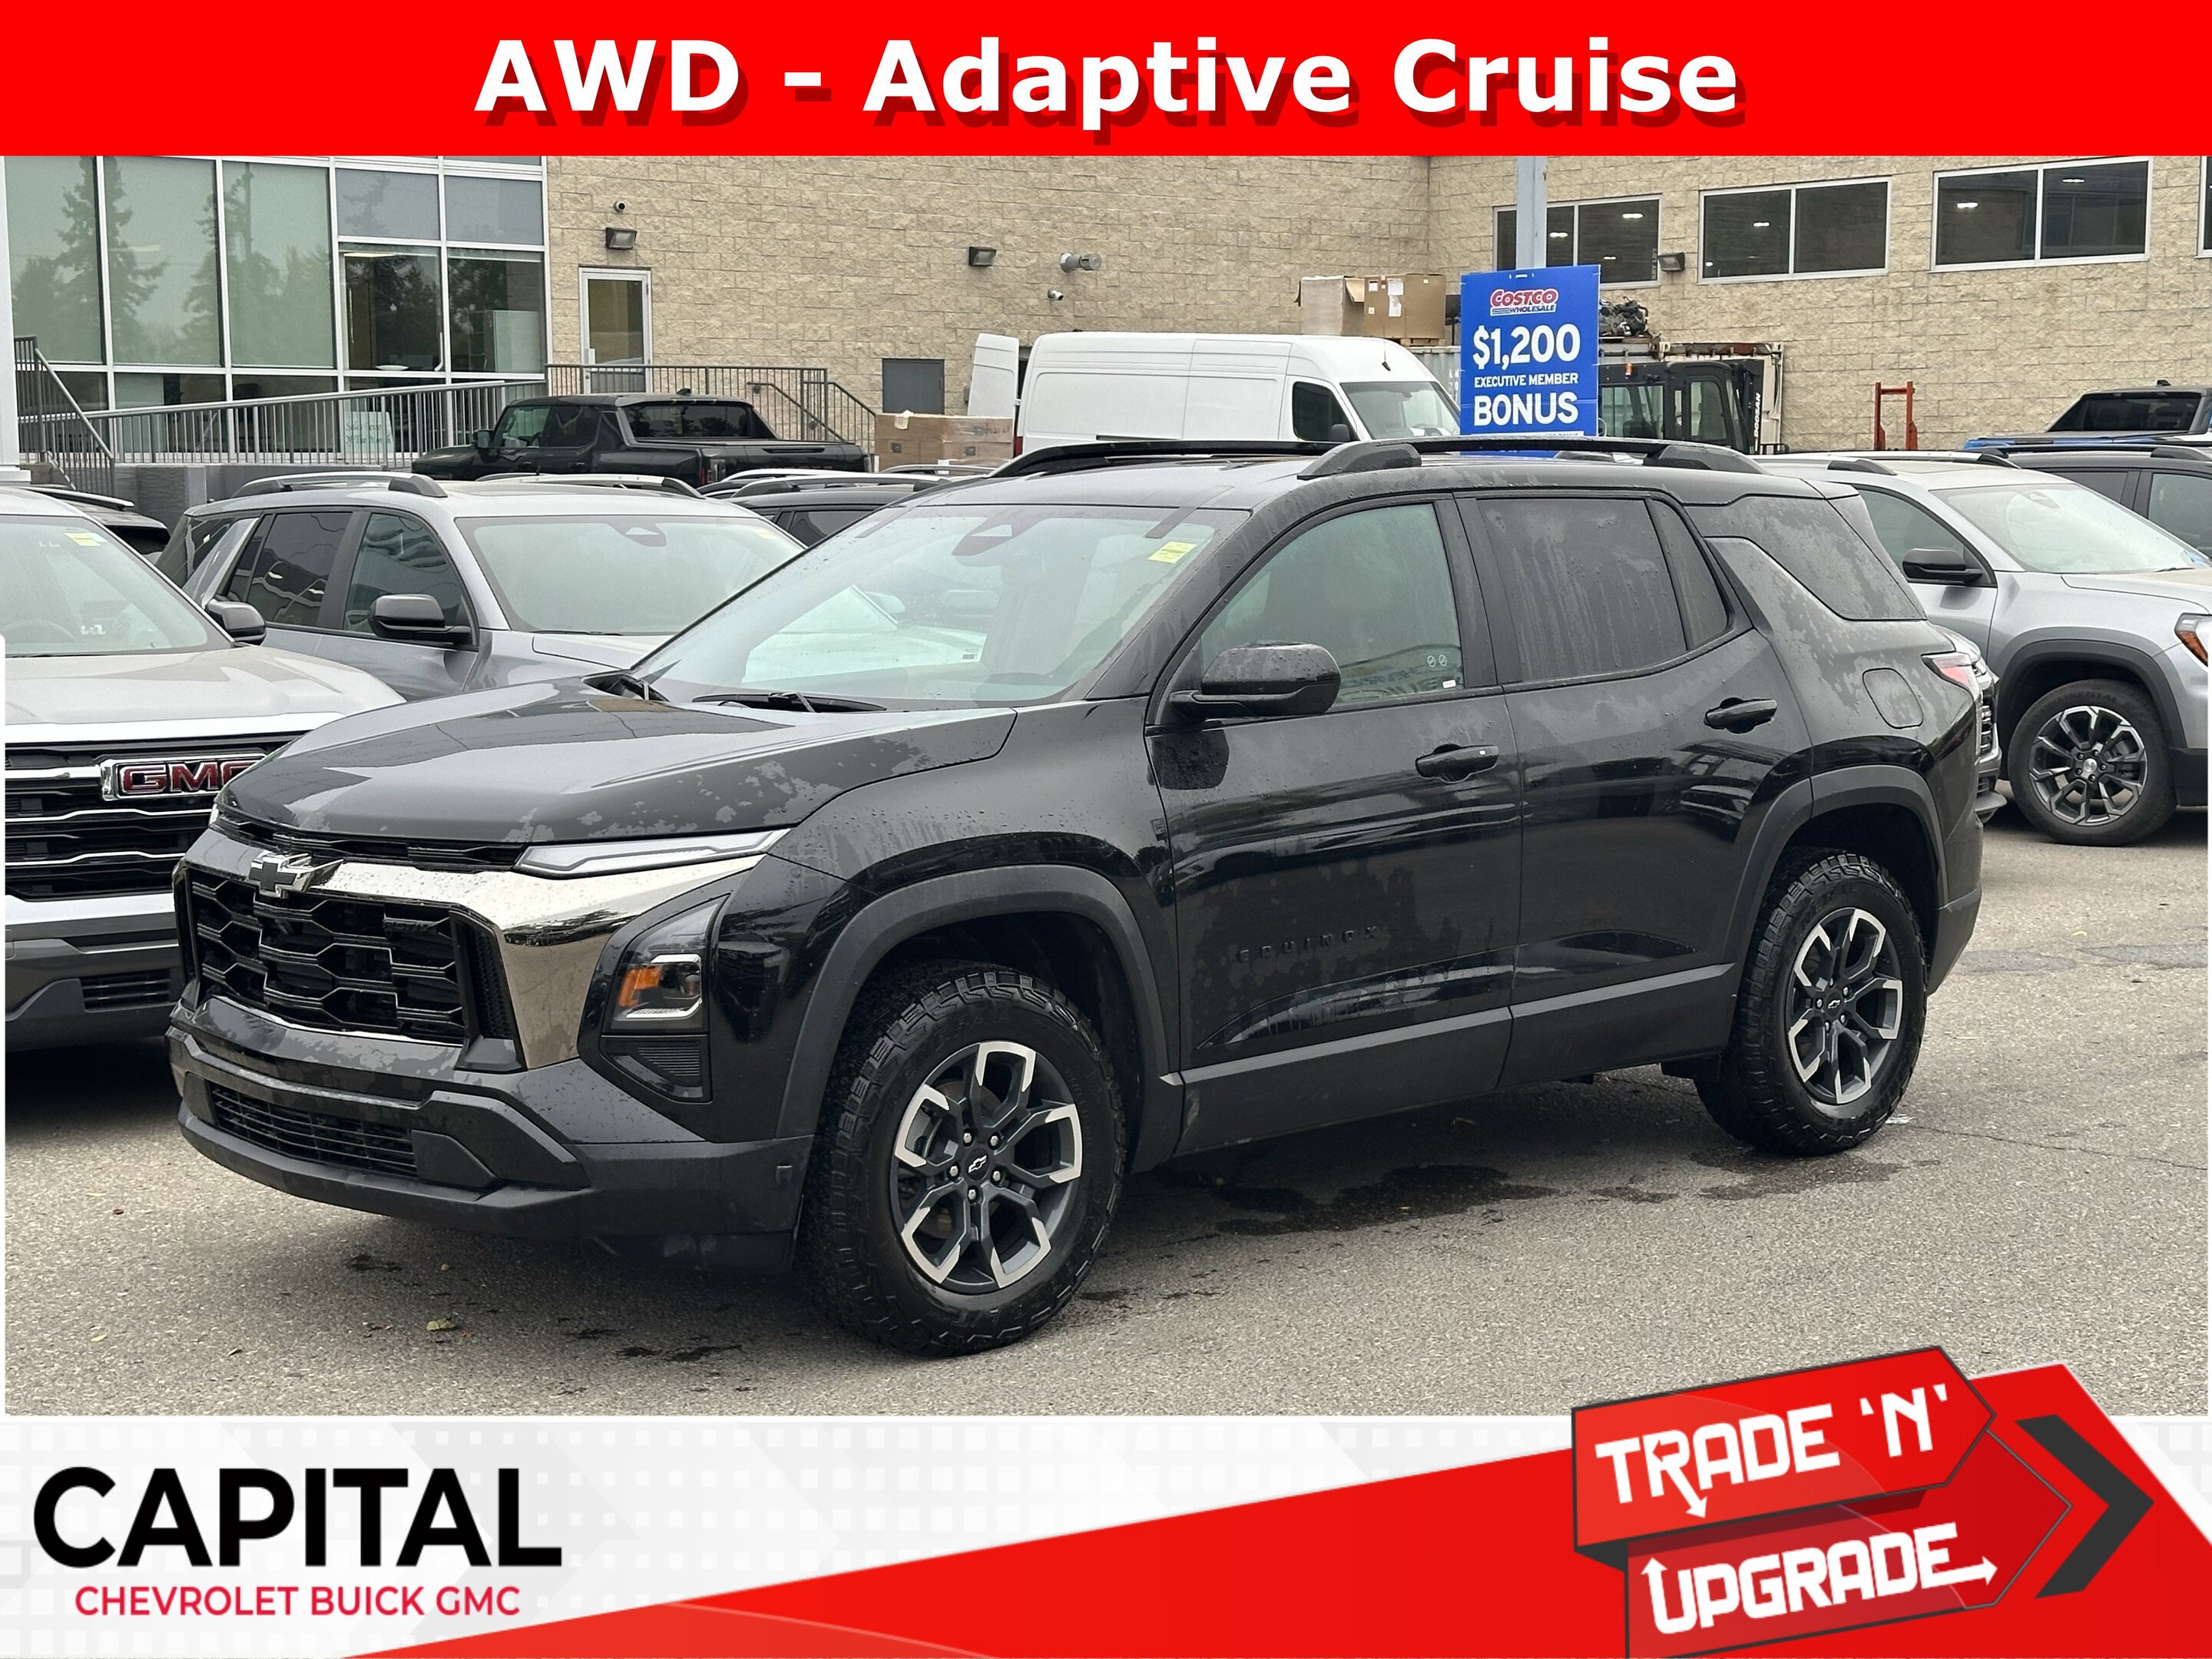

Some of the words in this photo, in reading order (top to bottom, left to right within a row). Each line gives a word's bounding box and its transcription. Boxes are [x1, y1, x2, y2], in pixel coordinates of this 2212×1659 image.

[1490, 289, 1558, 307] COSTCO
[1509, 304, 1555, 313] WHOLESALE
[1472, 323, 1581, 370] $1,200
[1474, 374, 1527, 389] EXECUTIVE
[1528, 372, 1579, 386] MEMBER
[1473, 391, 1579, 427] BONUS
[1237, 925, 1377, 962] EQUINOX
